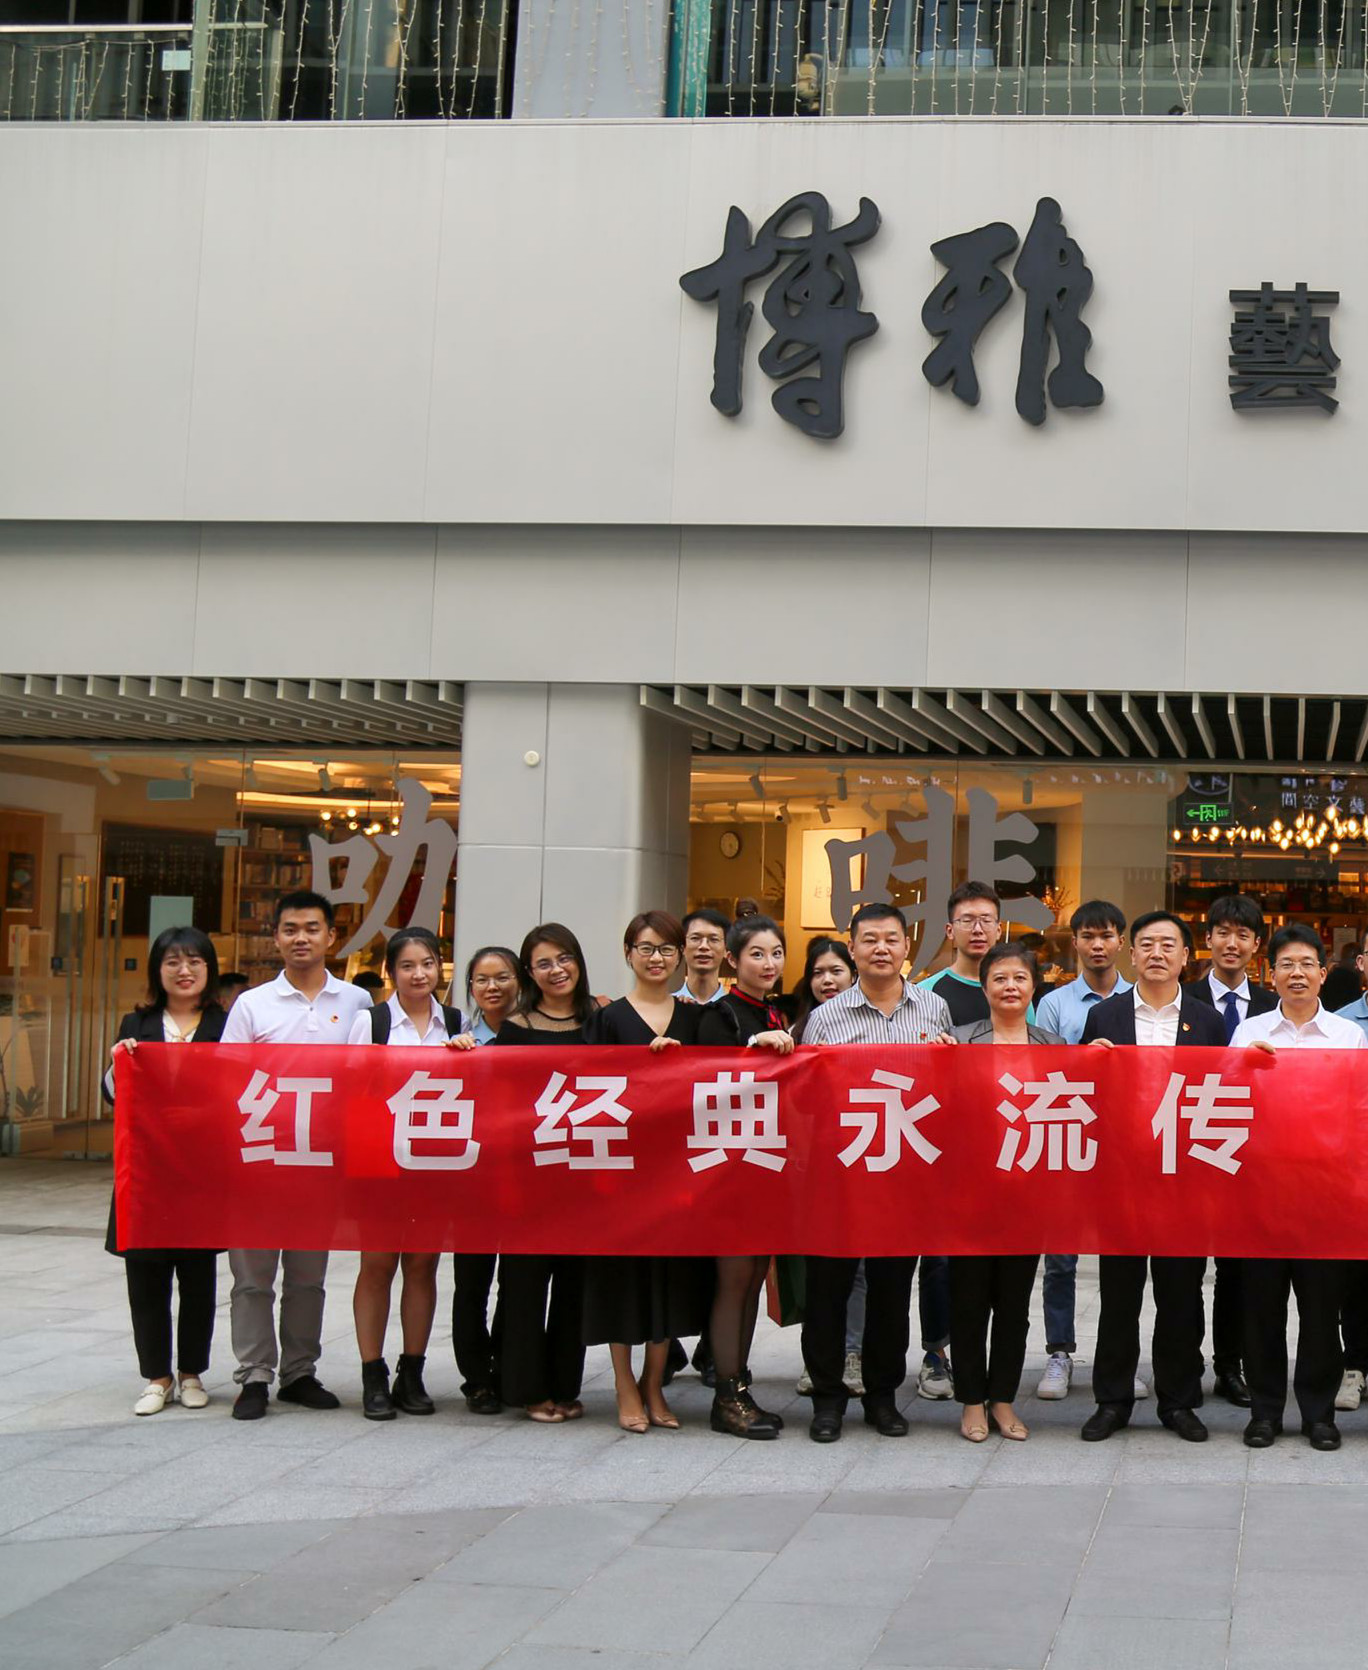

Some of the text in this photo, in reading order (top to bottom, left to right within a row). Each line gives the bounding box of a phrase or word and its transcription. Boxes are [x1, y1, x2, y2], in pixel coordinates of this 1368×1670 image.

[679, 191, 1104, 439] 博雅
[237, 1068, 1254, 1176] 红色经典永流传
